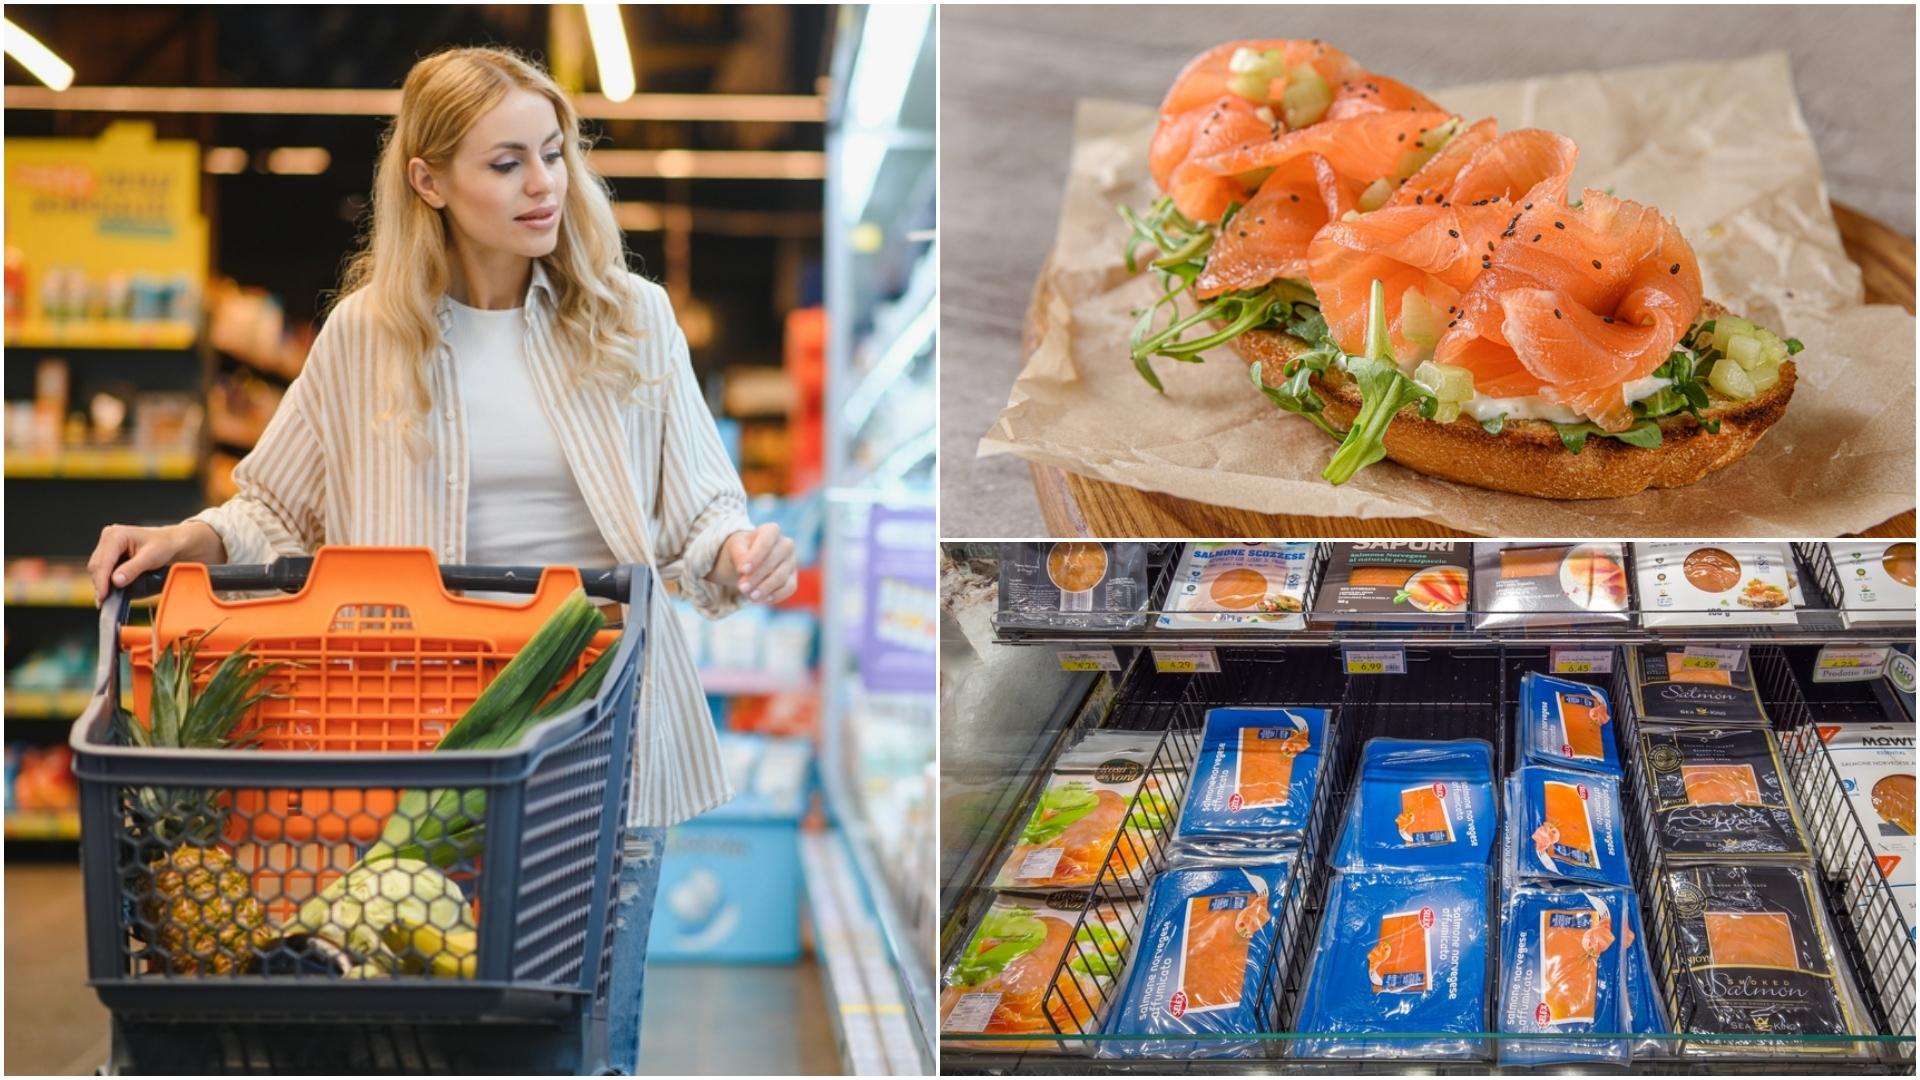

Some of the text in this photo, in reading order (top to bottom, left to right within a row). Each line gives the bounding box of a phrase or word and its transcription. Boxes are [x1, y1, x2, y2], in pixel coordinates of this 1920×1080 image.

[1193, 548, 1305, 560] SALMONE SCOZZESE
[1661, 685, 1736, 700] Salmon
[1896, 662, 1914, 681] Bio
[1440, 908, 1450, 961] affumicato
[1446, 906, 1461, 1000] salmone norvegese
[1139, 920, 1171, 1021] salmone norvegese
[1151, 958, 1172, 1020] affumicato
[1507, 932, 1528, 1025] salmone norvegese
[1703, 973, 1809, 998] Salmon
[1518, 969, 1533, 1026] affumicato
[1730, 1022, 1750, 1031] SEA
